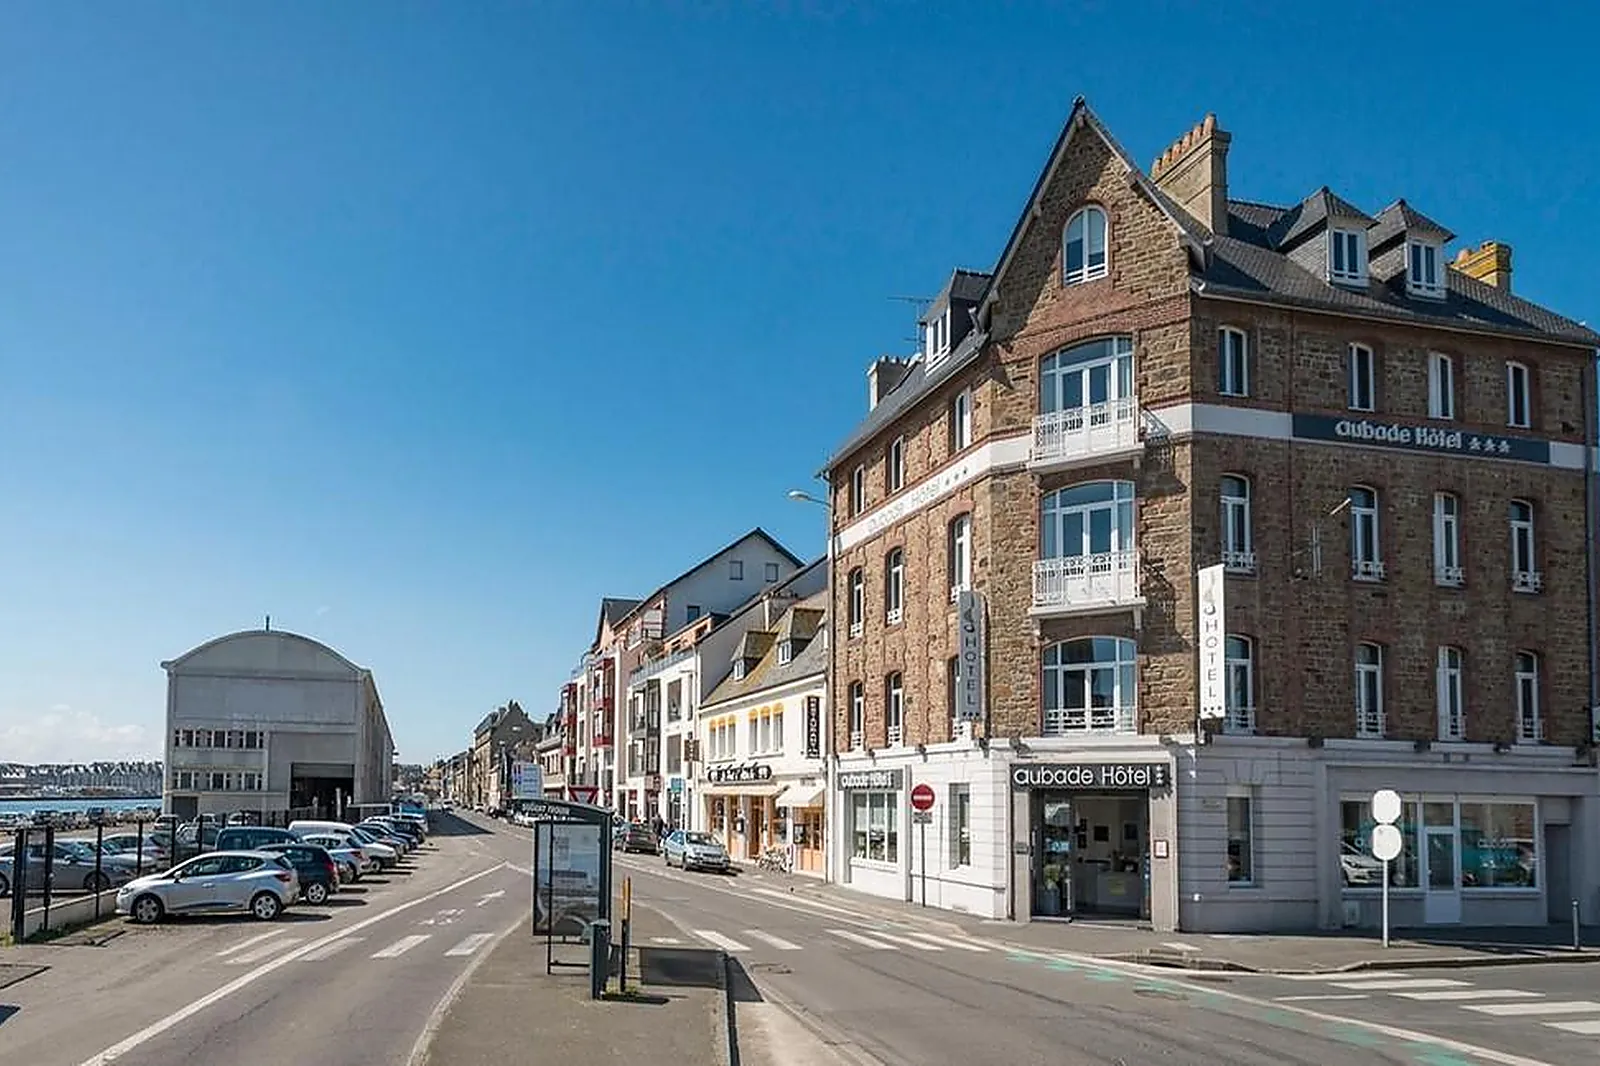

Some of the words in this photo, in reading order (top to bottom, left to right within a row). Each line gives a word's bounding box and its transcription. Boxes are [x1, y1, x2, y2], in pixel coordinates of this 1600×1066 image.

[1335, 420, 1410, 443] aubade
[1415, 427, 1462, 449] Hôtel
[964, 636, 977, 705] HOTEL
[1205, 619, 1218, 698] HOTEL
[1013, 765, 1094, 785] aubade
[1101, 765, 1150, 785] Hôtel
